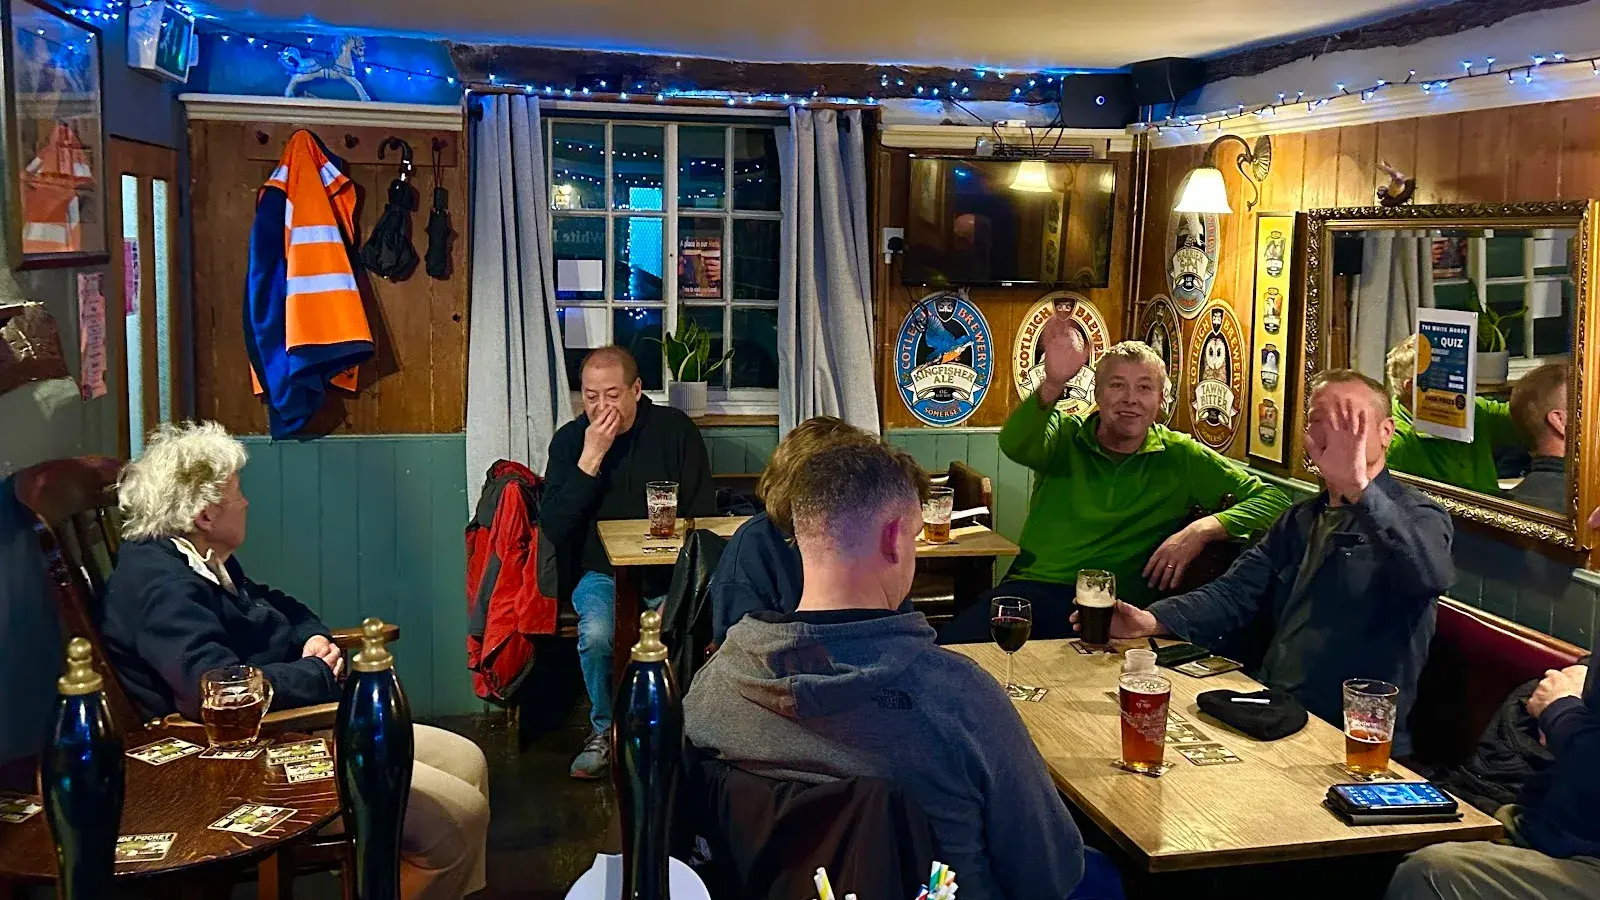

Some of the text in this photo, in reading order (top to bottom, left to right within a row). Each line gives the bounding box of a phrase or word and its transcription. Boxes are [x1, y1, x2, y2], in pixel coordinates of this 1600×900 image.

[1432, 325, 1448, 333] WHITE
[957, 307, 987, 370] BREWERY
[1019, 306, 1053, 369] COTLEIGH
[1440, 337, 1464, 349] QUIZ
[1190, 319, 1210, 385] COTLEIGH
[1223, 320, 1241, 391] BREWERY
[913, 366, 976, 383] KINGFISHER
[933, 374, 955, 384] ALE
[1201, 383, 1228, 398] TAWNY
[1201, 394, 1228, 411] BITTER
[924, 407, 962, 417] SOMERSET
[134, 833, 172, 841] POCKET
